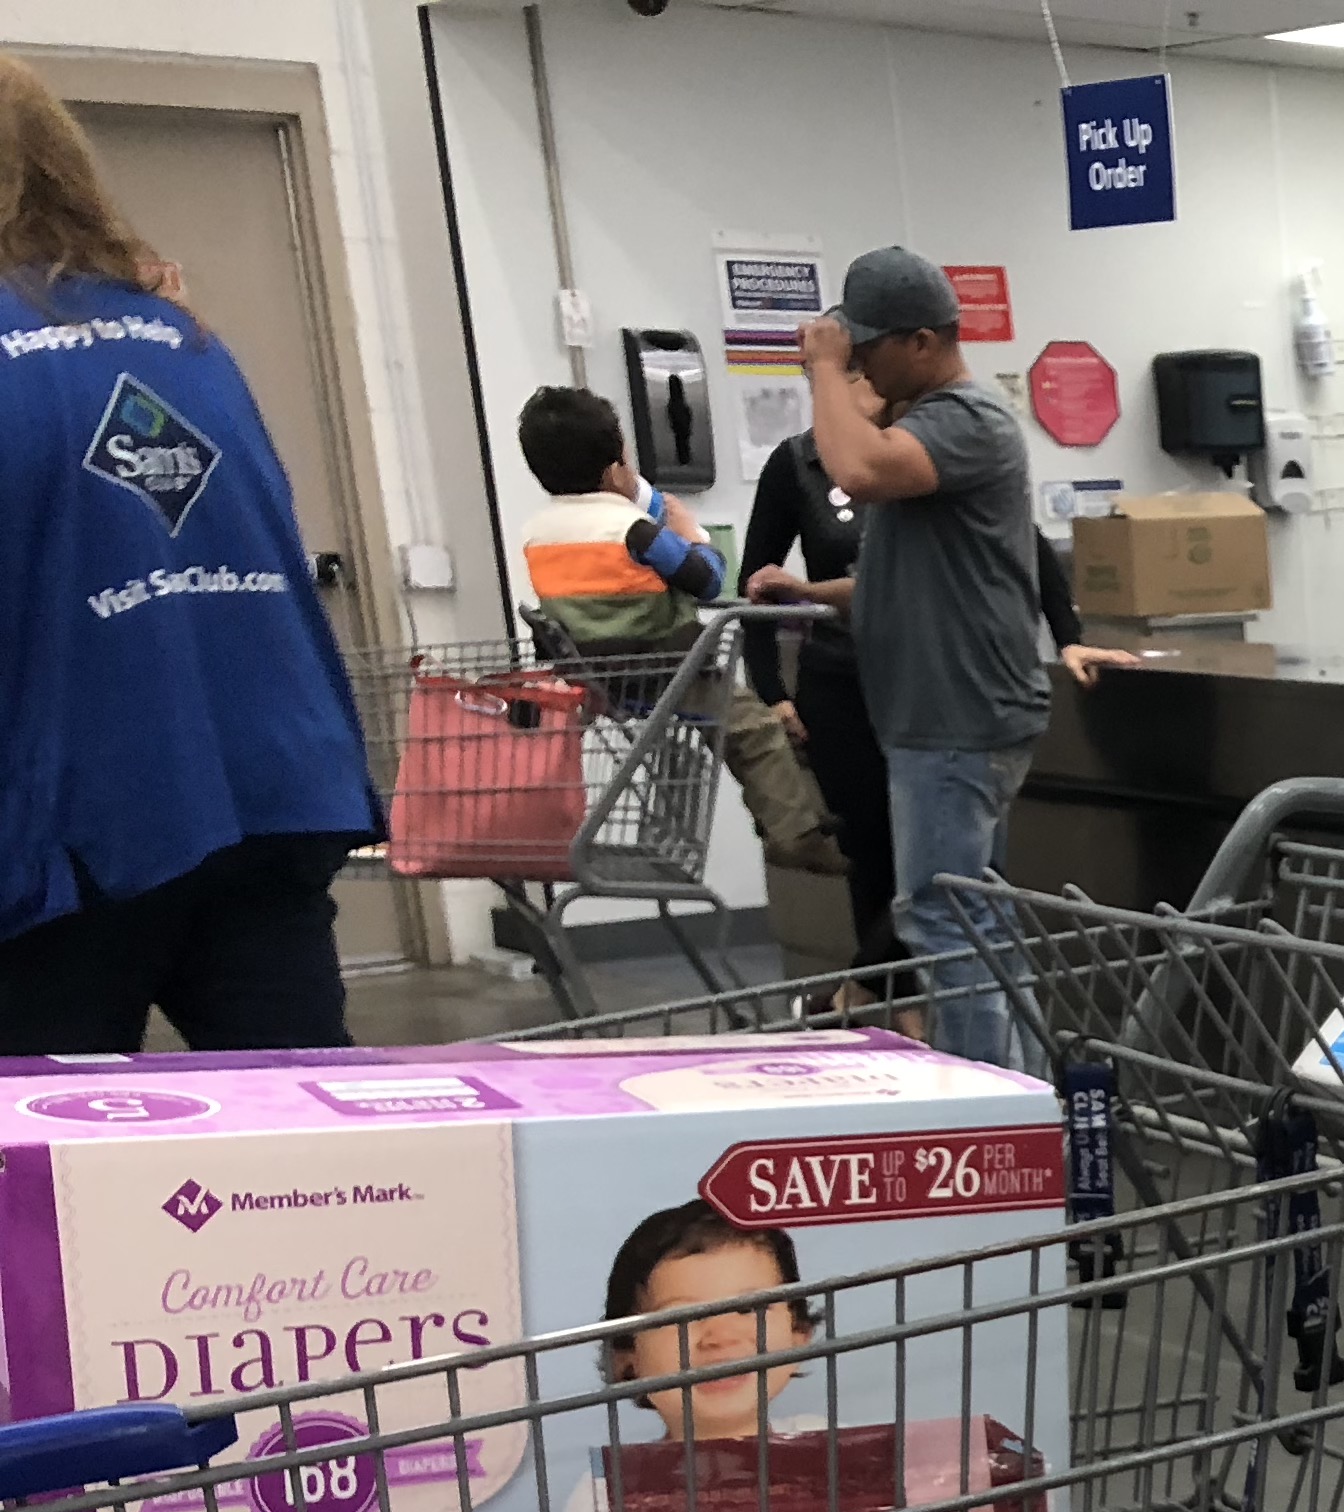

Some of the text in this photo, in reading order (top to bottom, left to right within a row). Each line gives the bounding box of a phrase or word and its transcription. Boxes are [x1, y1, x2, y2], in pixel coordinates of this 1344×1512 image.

[1078, 118, 1153, 154] Pick Up
[1088, 157, 1147, 190] Order
[88, 579, 152, 619] Visit
[230, 1182, 413, 1212] Member's Mark
[750, 1144, 1015, 1213] SAVE UP $26 PER
[883, 1176, 907, 1203] TO
[161, 1255, 438, 1323] Comfort Care
[111, 1308, 491, 1404] Diapers
